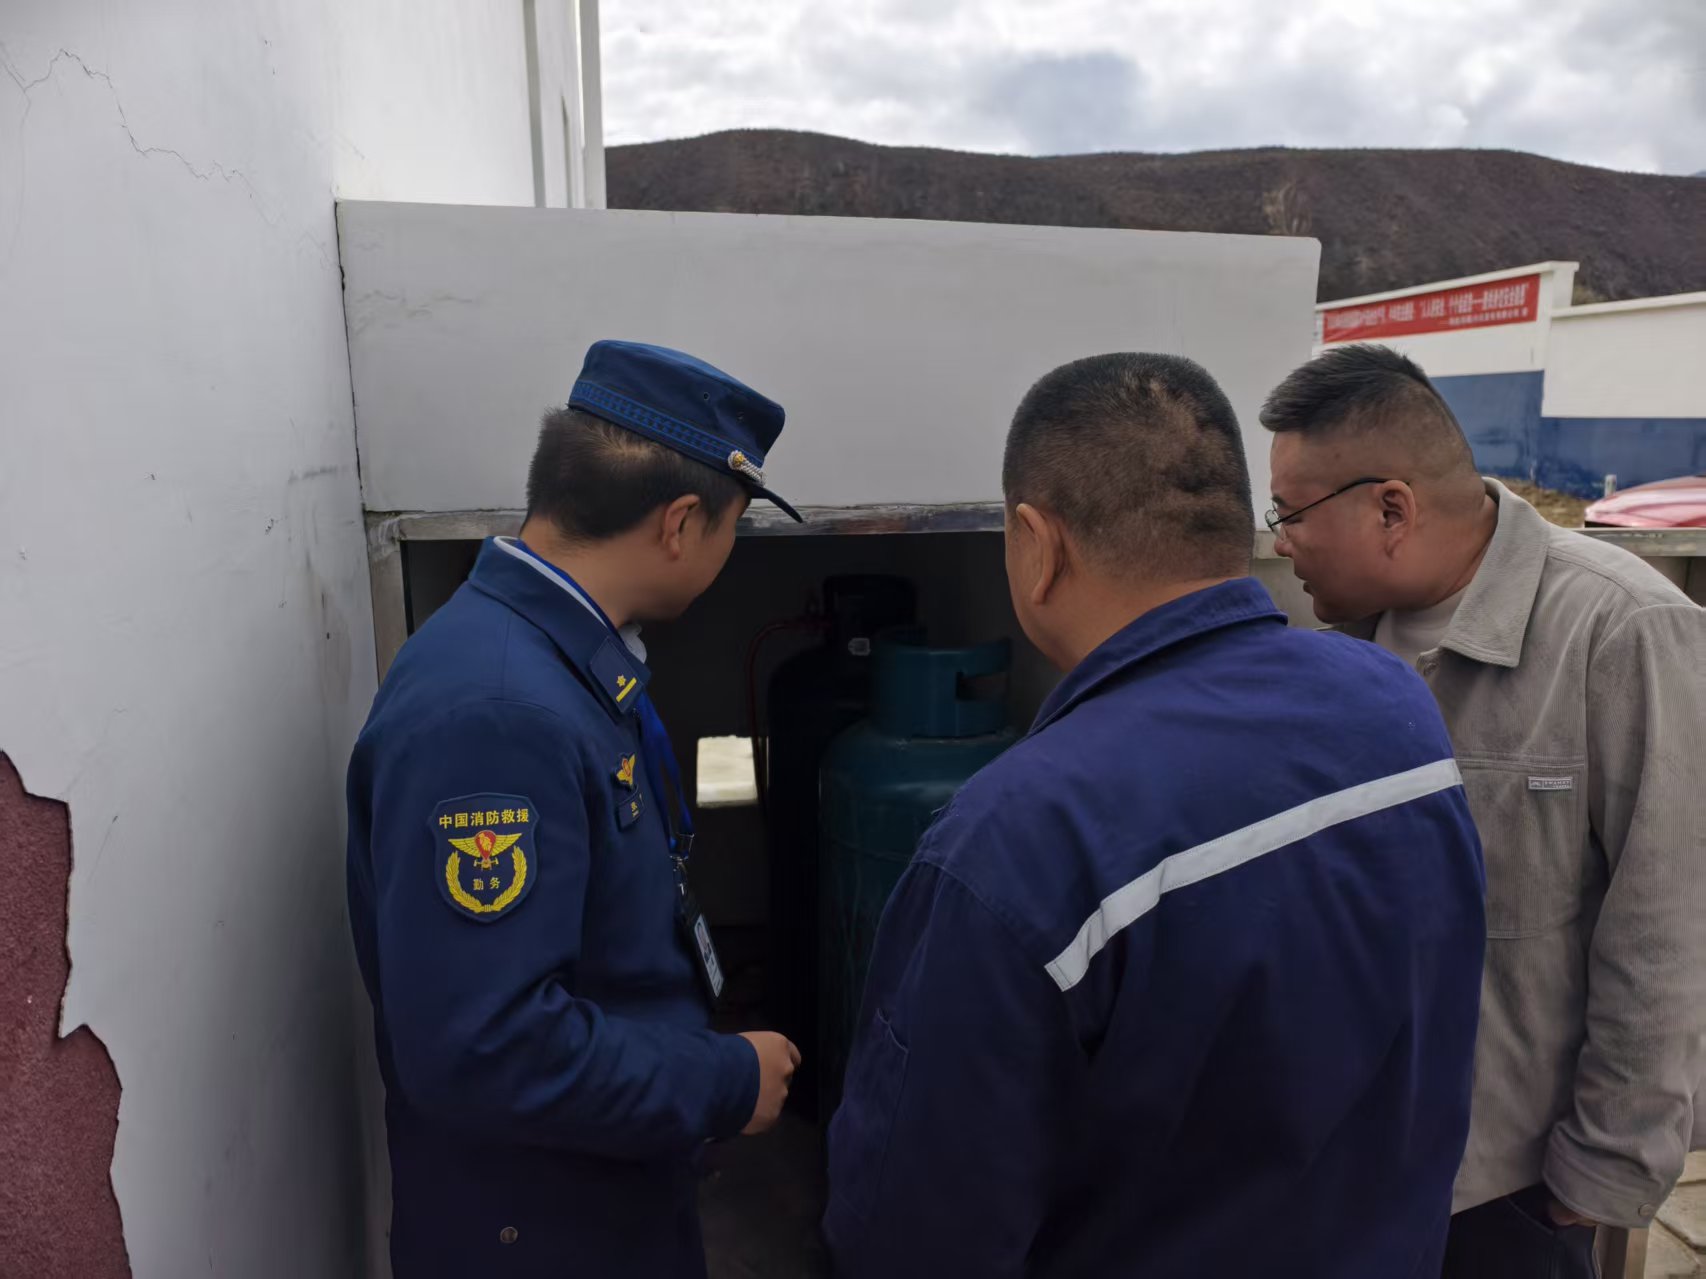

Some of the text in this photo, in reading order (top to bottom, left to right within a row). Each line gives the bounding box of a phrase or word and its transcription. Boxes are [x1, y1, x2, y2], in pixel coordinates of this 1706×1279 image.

[439, 808, 529, 829] 中国消防救援
[473, 877, 500, 890] 勤务
